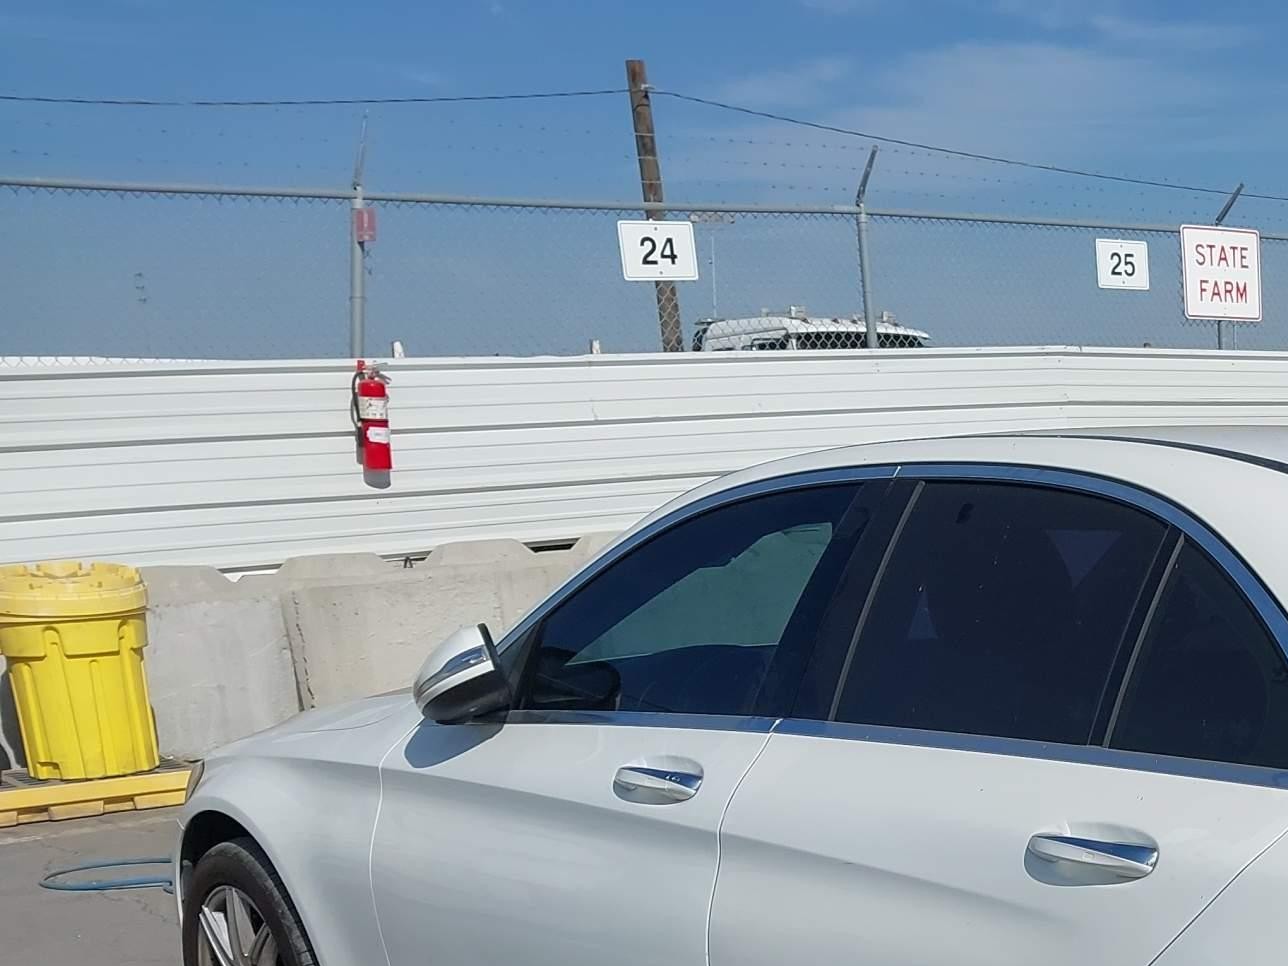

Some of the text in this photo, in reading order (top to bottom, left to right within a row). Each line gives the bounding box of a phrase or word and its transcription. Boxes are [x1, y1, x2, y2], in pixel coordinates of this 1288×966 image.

[639, 236, 678, 265] 24
[1195, 244, 1249, 269] STATE
[1110, 252, 1136, 277] 25
[1199, 279, 1248, 304] FARM
